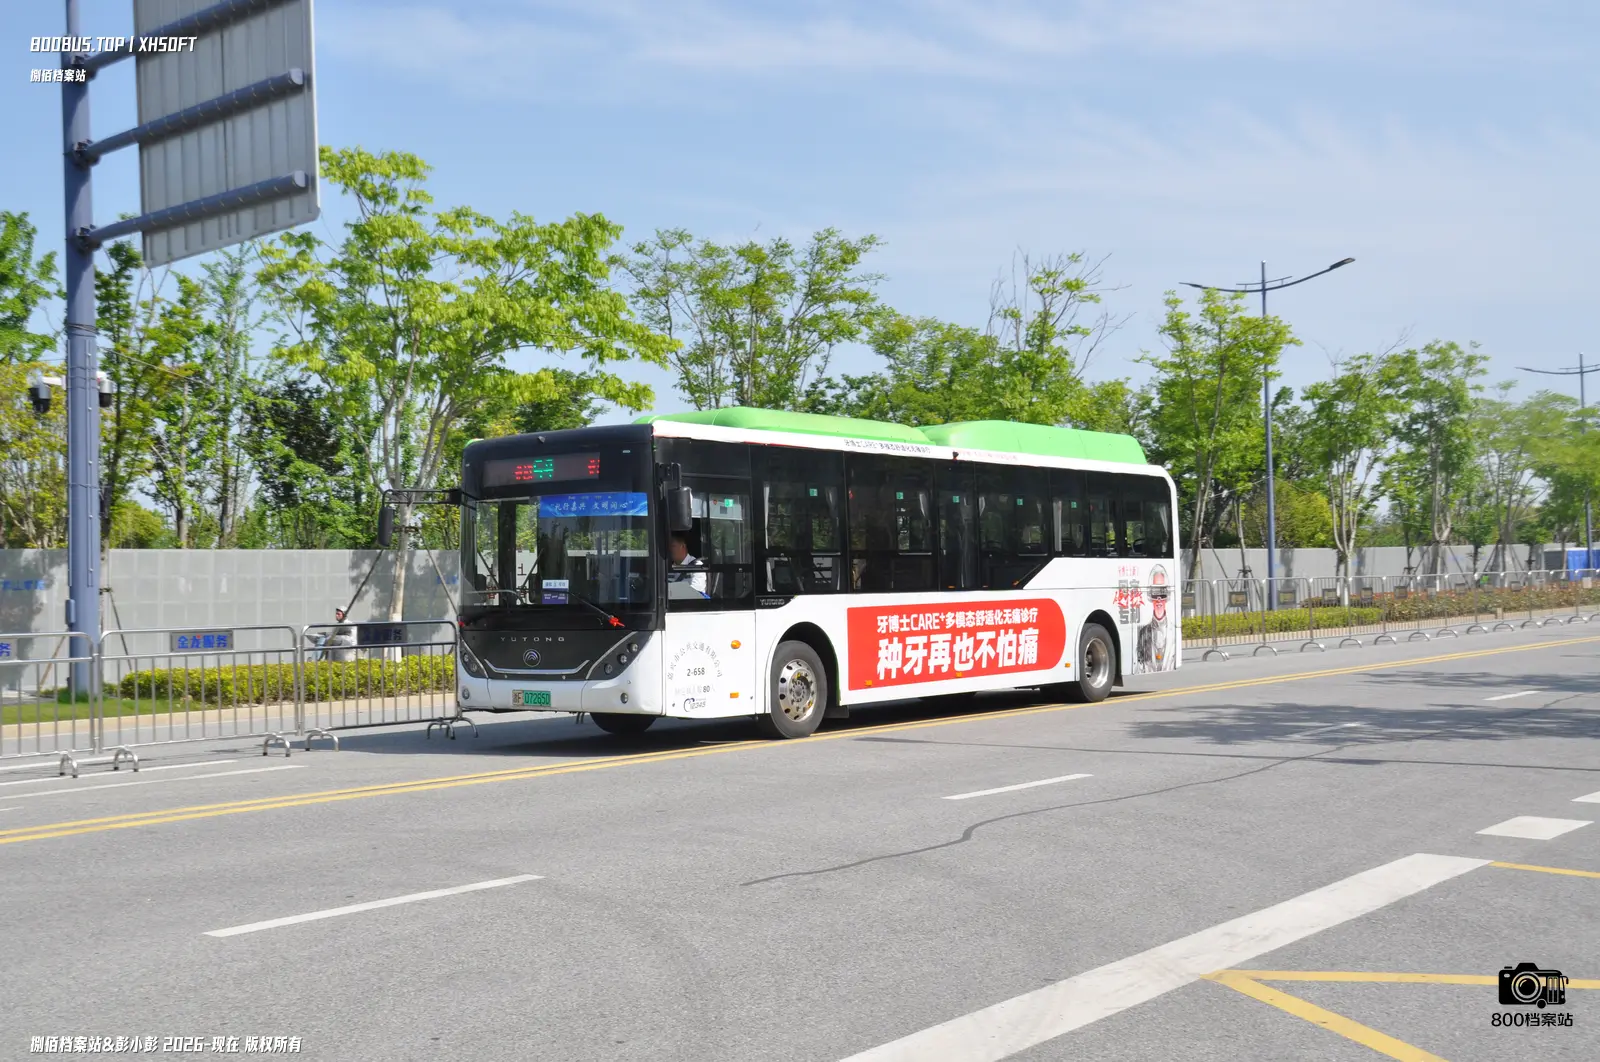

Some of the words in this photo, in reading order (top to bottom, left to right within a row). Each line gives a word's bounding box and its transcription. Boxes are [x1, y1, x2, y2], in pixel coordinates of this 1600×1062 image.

[876, 607, 1039, 634] 牙博士CARE+多模态舒适化无痛诊疗
[876, 627, 1039, 681] 种牙再也不怕痛
[686, 667, 706, 677] 2-658
